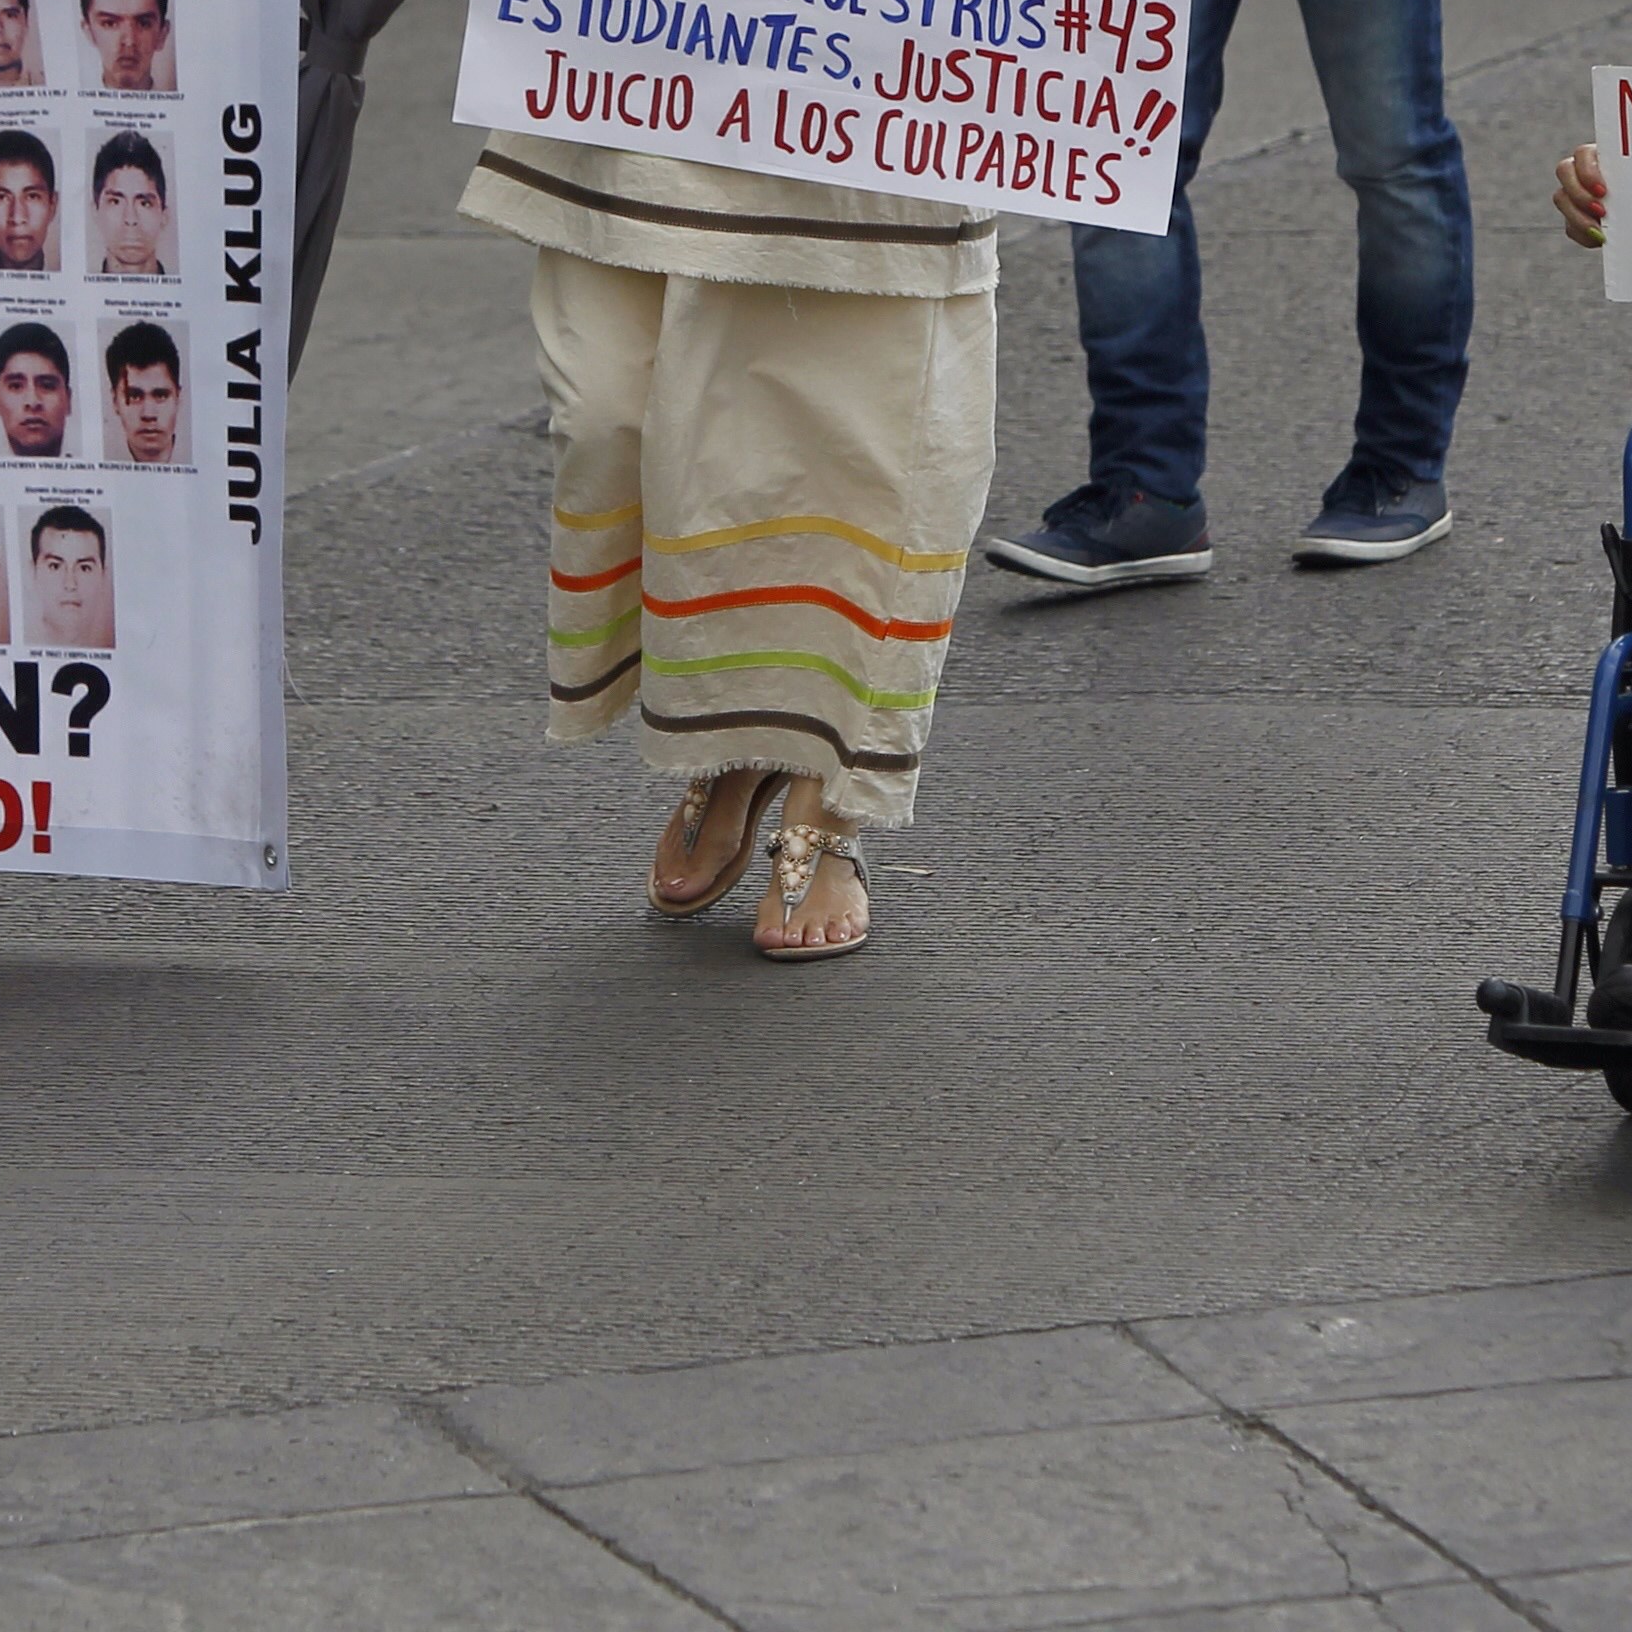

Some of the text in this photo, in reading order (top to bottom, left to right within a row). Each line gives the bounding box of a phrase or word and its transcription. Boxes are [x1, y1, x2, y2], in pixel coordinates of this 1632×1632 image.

[524, 48, 1124, 207] JUICIO A LOS CULPABLES
[873, 38, 1179, 158] JUSTICIA!!
[220, 101, 264, 548] JULIA KLUG
